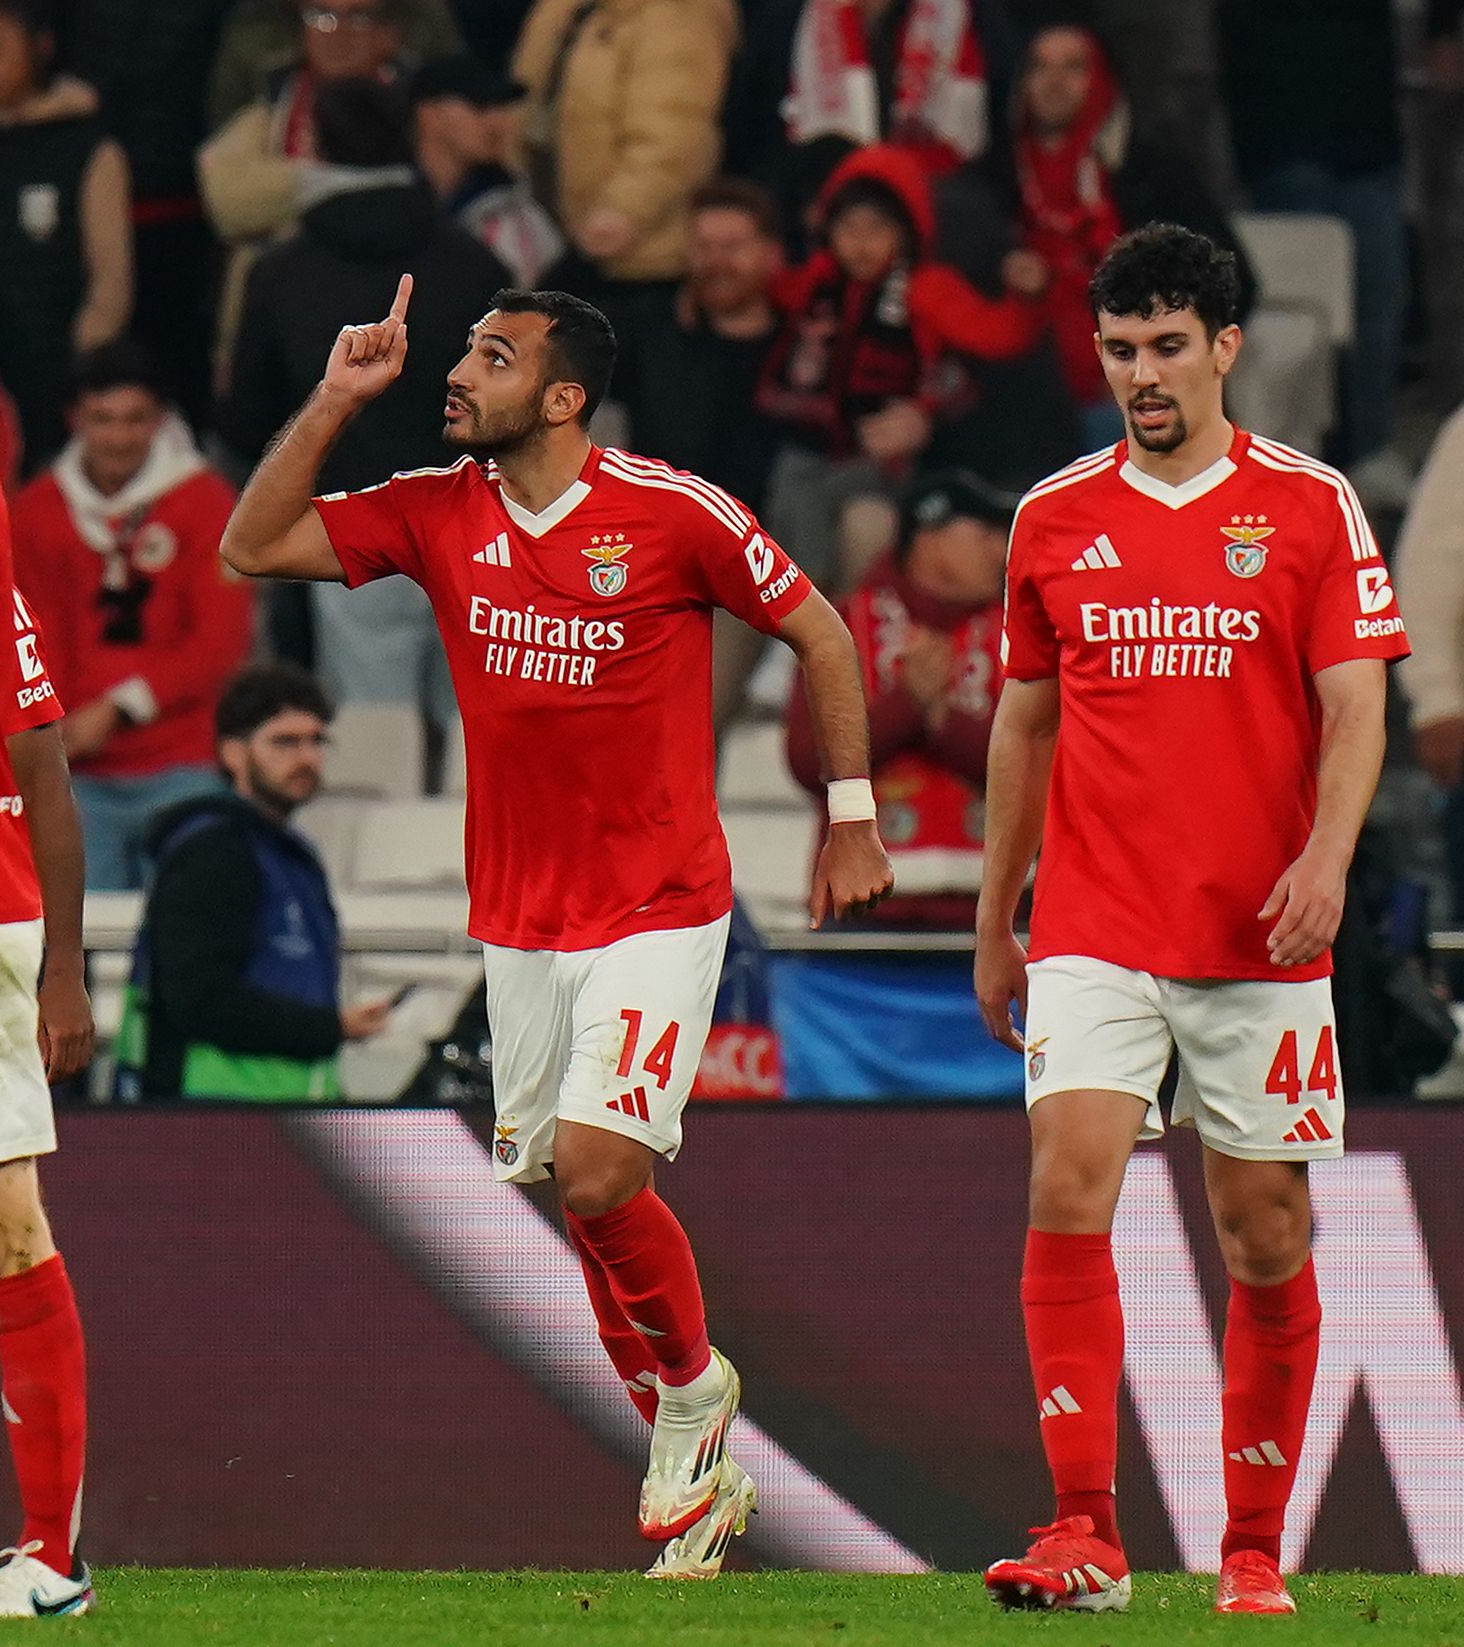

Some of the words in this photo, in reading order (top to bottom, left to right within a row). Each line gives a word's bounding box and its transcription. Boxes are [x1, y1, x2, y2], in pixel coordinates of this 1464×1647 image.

[759, 562, 799, 604] etano
[468, 595, 625, 652] Emirates
[1079, 597, 1261, 643] Emirates
[1354, 616, 1406, 639] Betan
[485, 643, 518, 676] FLY
[520, 649, 597, 686] BETTER
[1110, 644, 1146, 678] FLY
[1150, 644, 1233, 678] BETTER
[16, 680, 55, 709] Bet
[615, 1008, 680, 1090] 14
[1265, 1024, 1337, 1105] 44
